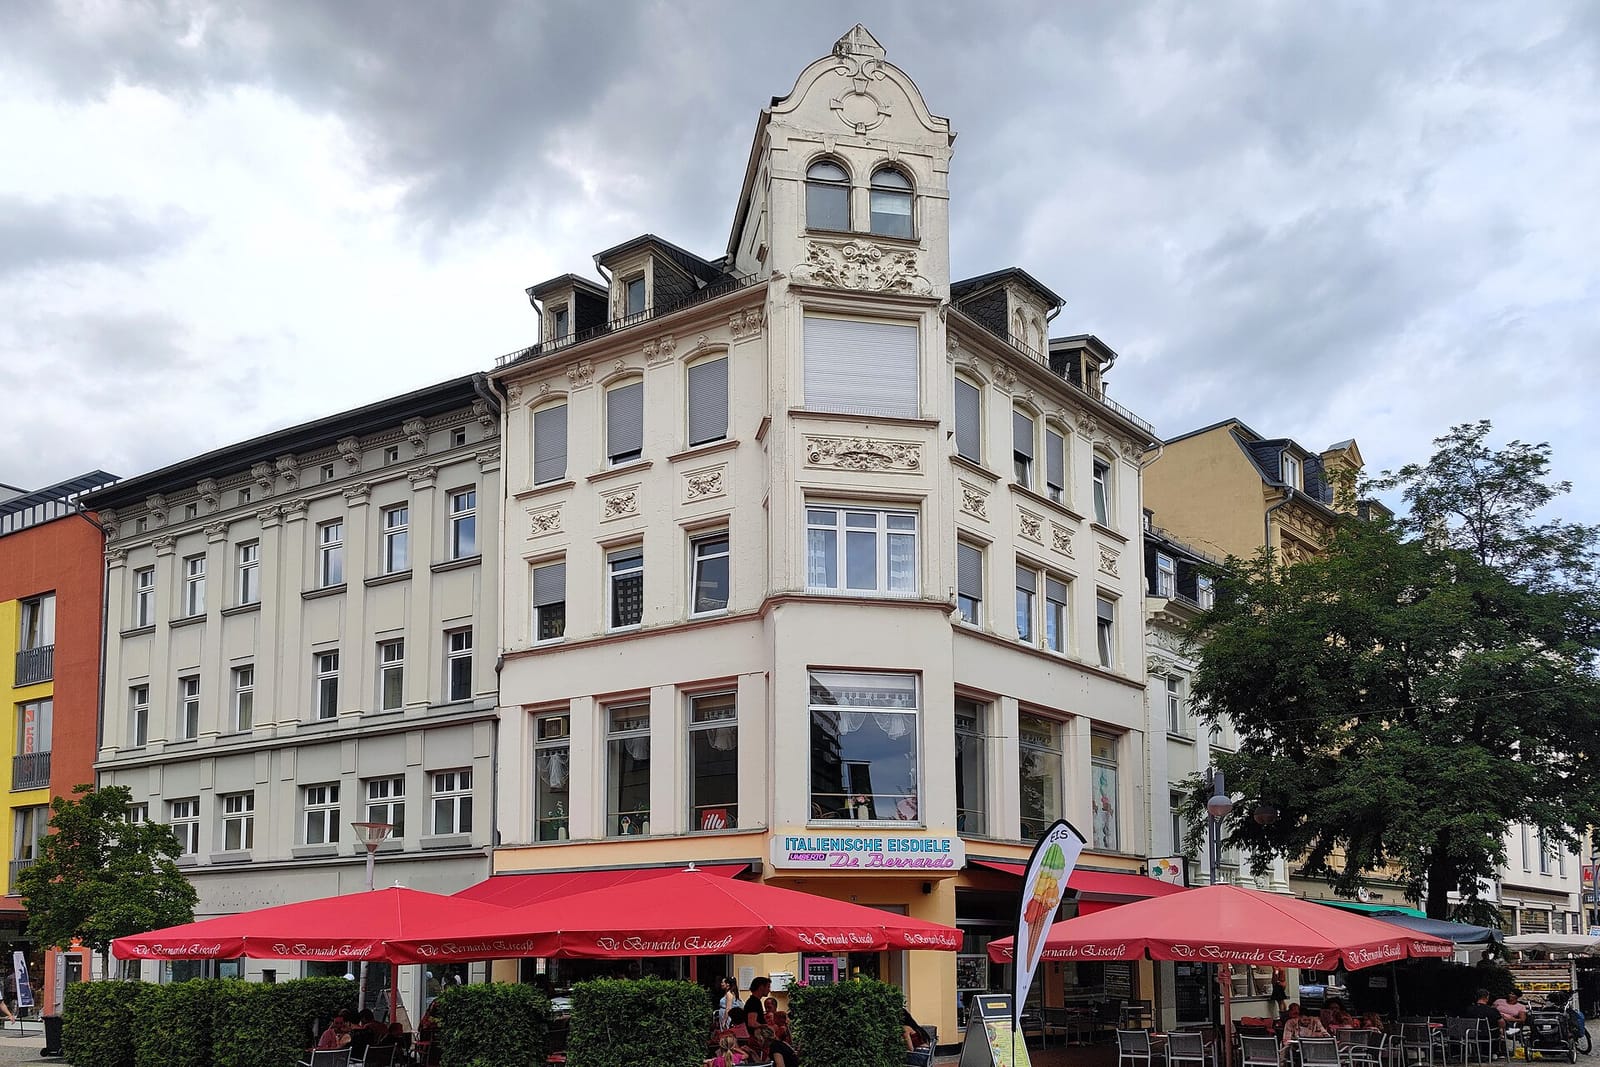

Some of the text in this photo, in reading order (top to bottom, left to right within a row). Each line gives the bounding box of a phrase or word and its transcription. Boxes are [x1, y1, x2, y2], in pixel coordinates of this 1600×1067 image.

[703, 813, 725, 830] illy
[1050, 830, 1068, 842] EIS
[786, 838, 950, 852] ITALIENISCHE EISDIELE
[829, 852, 954, 868] De Bernardo
[272, 944, 289, 956] De
[416, 944, 438, 956] De
[440, 942, 492, 954] Bernardo
[596, 934, 732, 951] De Bernardo Eiscafé
[1041, 944, 1126, 960] ernardo Eiscafé
[1170, 944, 1324, 968] De Bernardo Eiscafé
